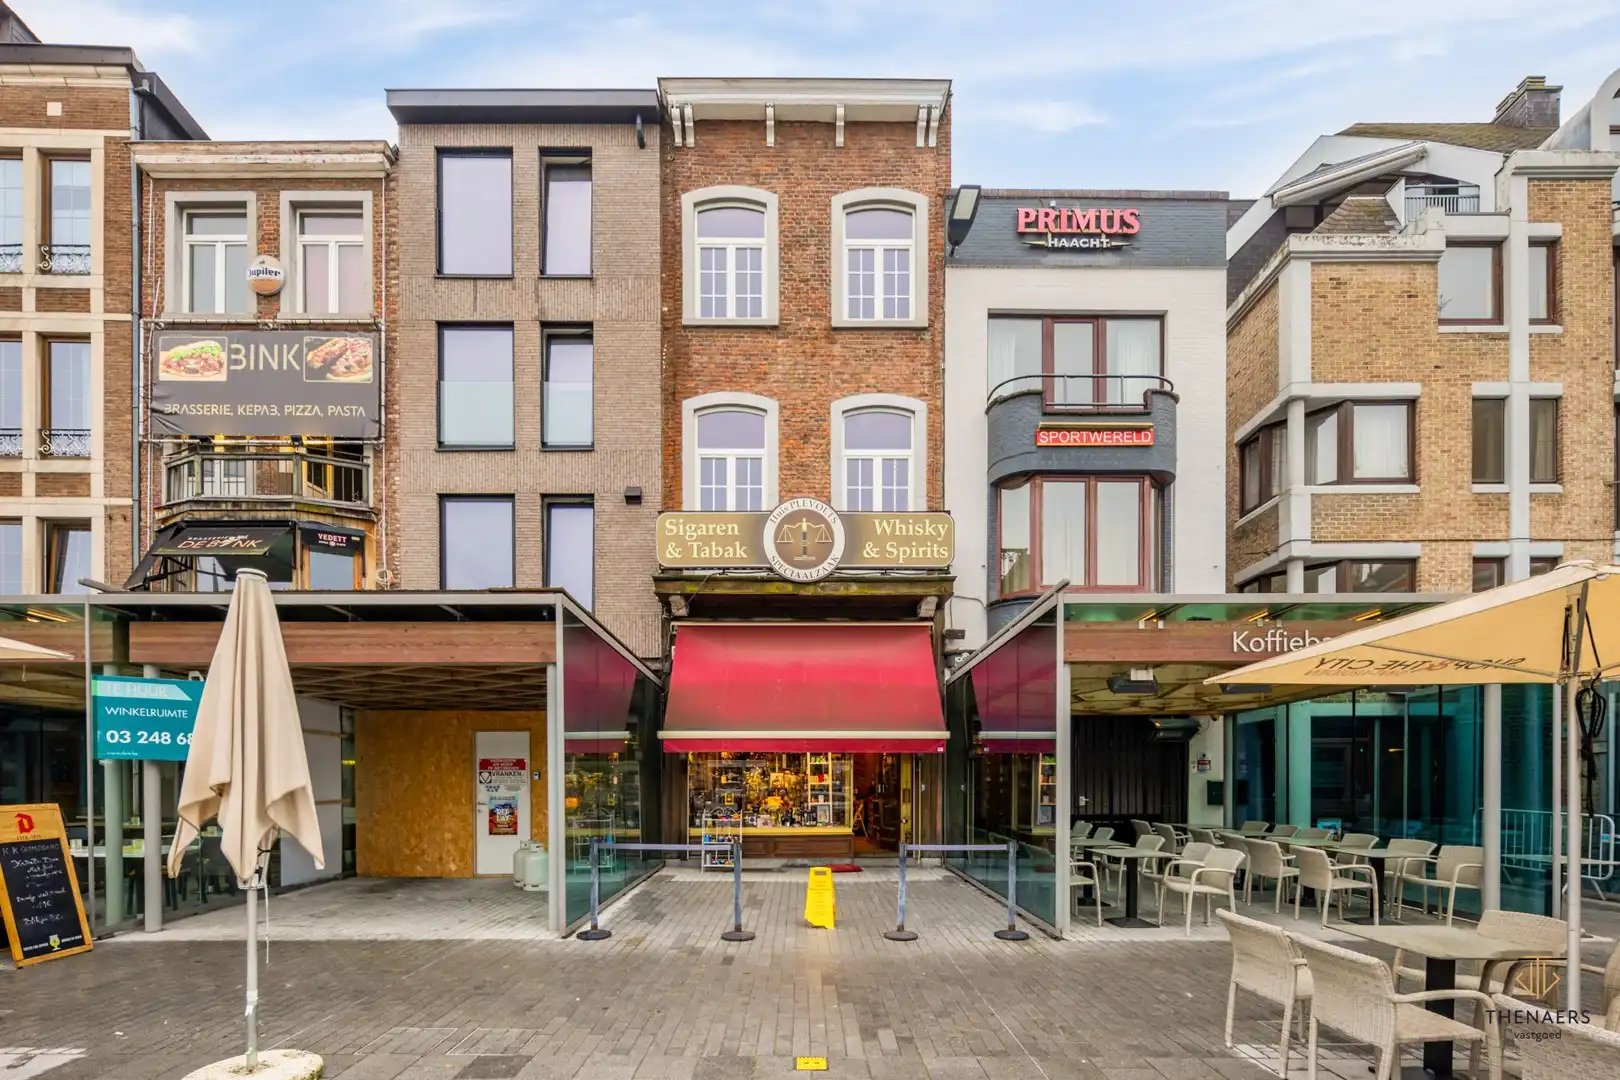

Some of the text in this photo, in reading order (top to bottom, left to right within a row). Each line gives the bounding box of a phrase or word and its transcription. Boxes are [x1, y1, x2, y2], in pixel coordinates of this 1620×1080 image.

[1017, 207, 1141, 235] PRIMUS
[1048, 237, 1110, 248] HAACHT
[248, 266, 281, 277] Jupiler
[230, 344, 300, 371] BINK
[164, 403, 366, 418] BRASSERIE, KEPAB, PIZZA, PASTA
[1039, 431, 1152, 444] SPORTWERELD
[769, 499, 838, 524] Huis PLEVOETS
[665, 518, 740, 541] Sigaren
[873, 518, 949, 541] Whisky
[317, 533, 348, 543] VEDETT
[665, 541, 748, 558] & Tabak
[863, 541, 949, 564] & Spirits
[769, 553, 840, 580] SPECIAALZAAK
[126, 683, 168, 697] HUUR
[104, 706, 188, 719] WINKELRUIMTE
[105, 729, 132, 744] 03
[137, 731, 172, 745] 248
